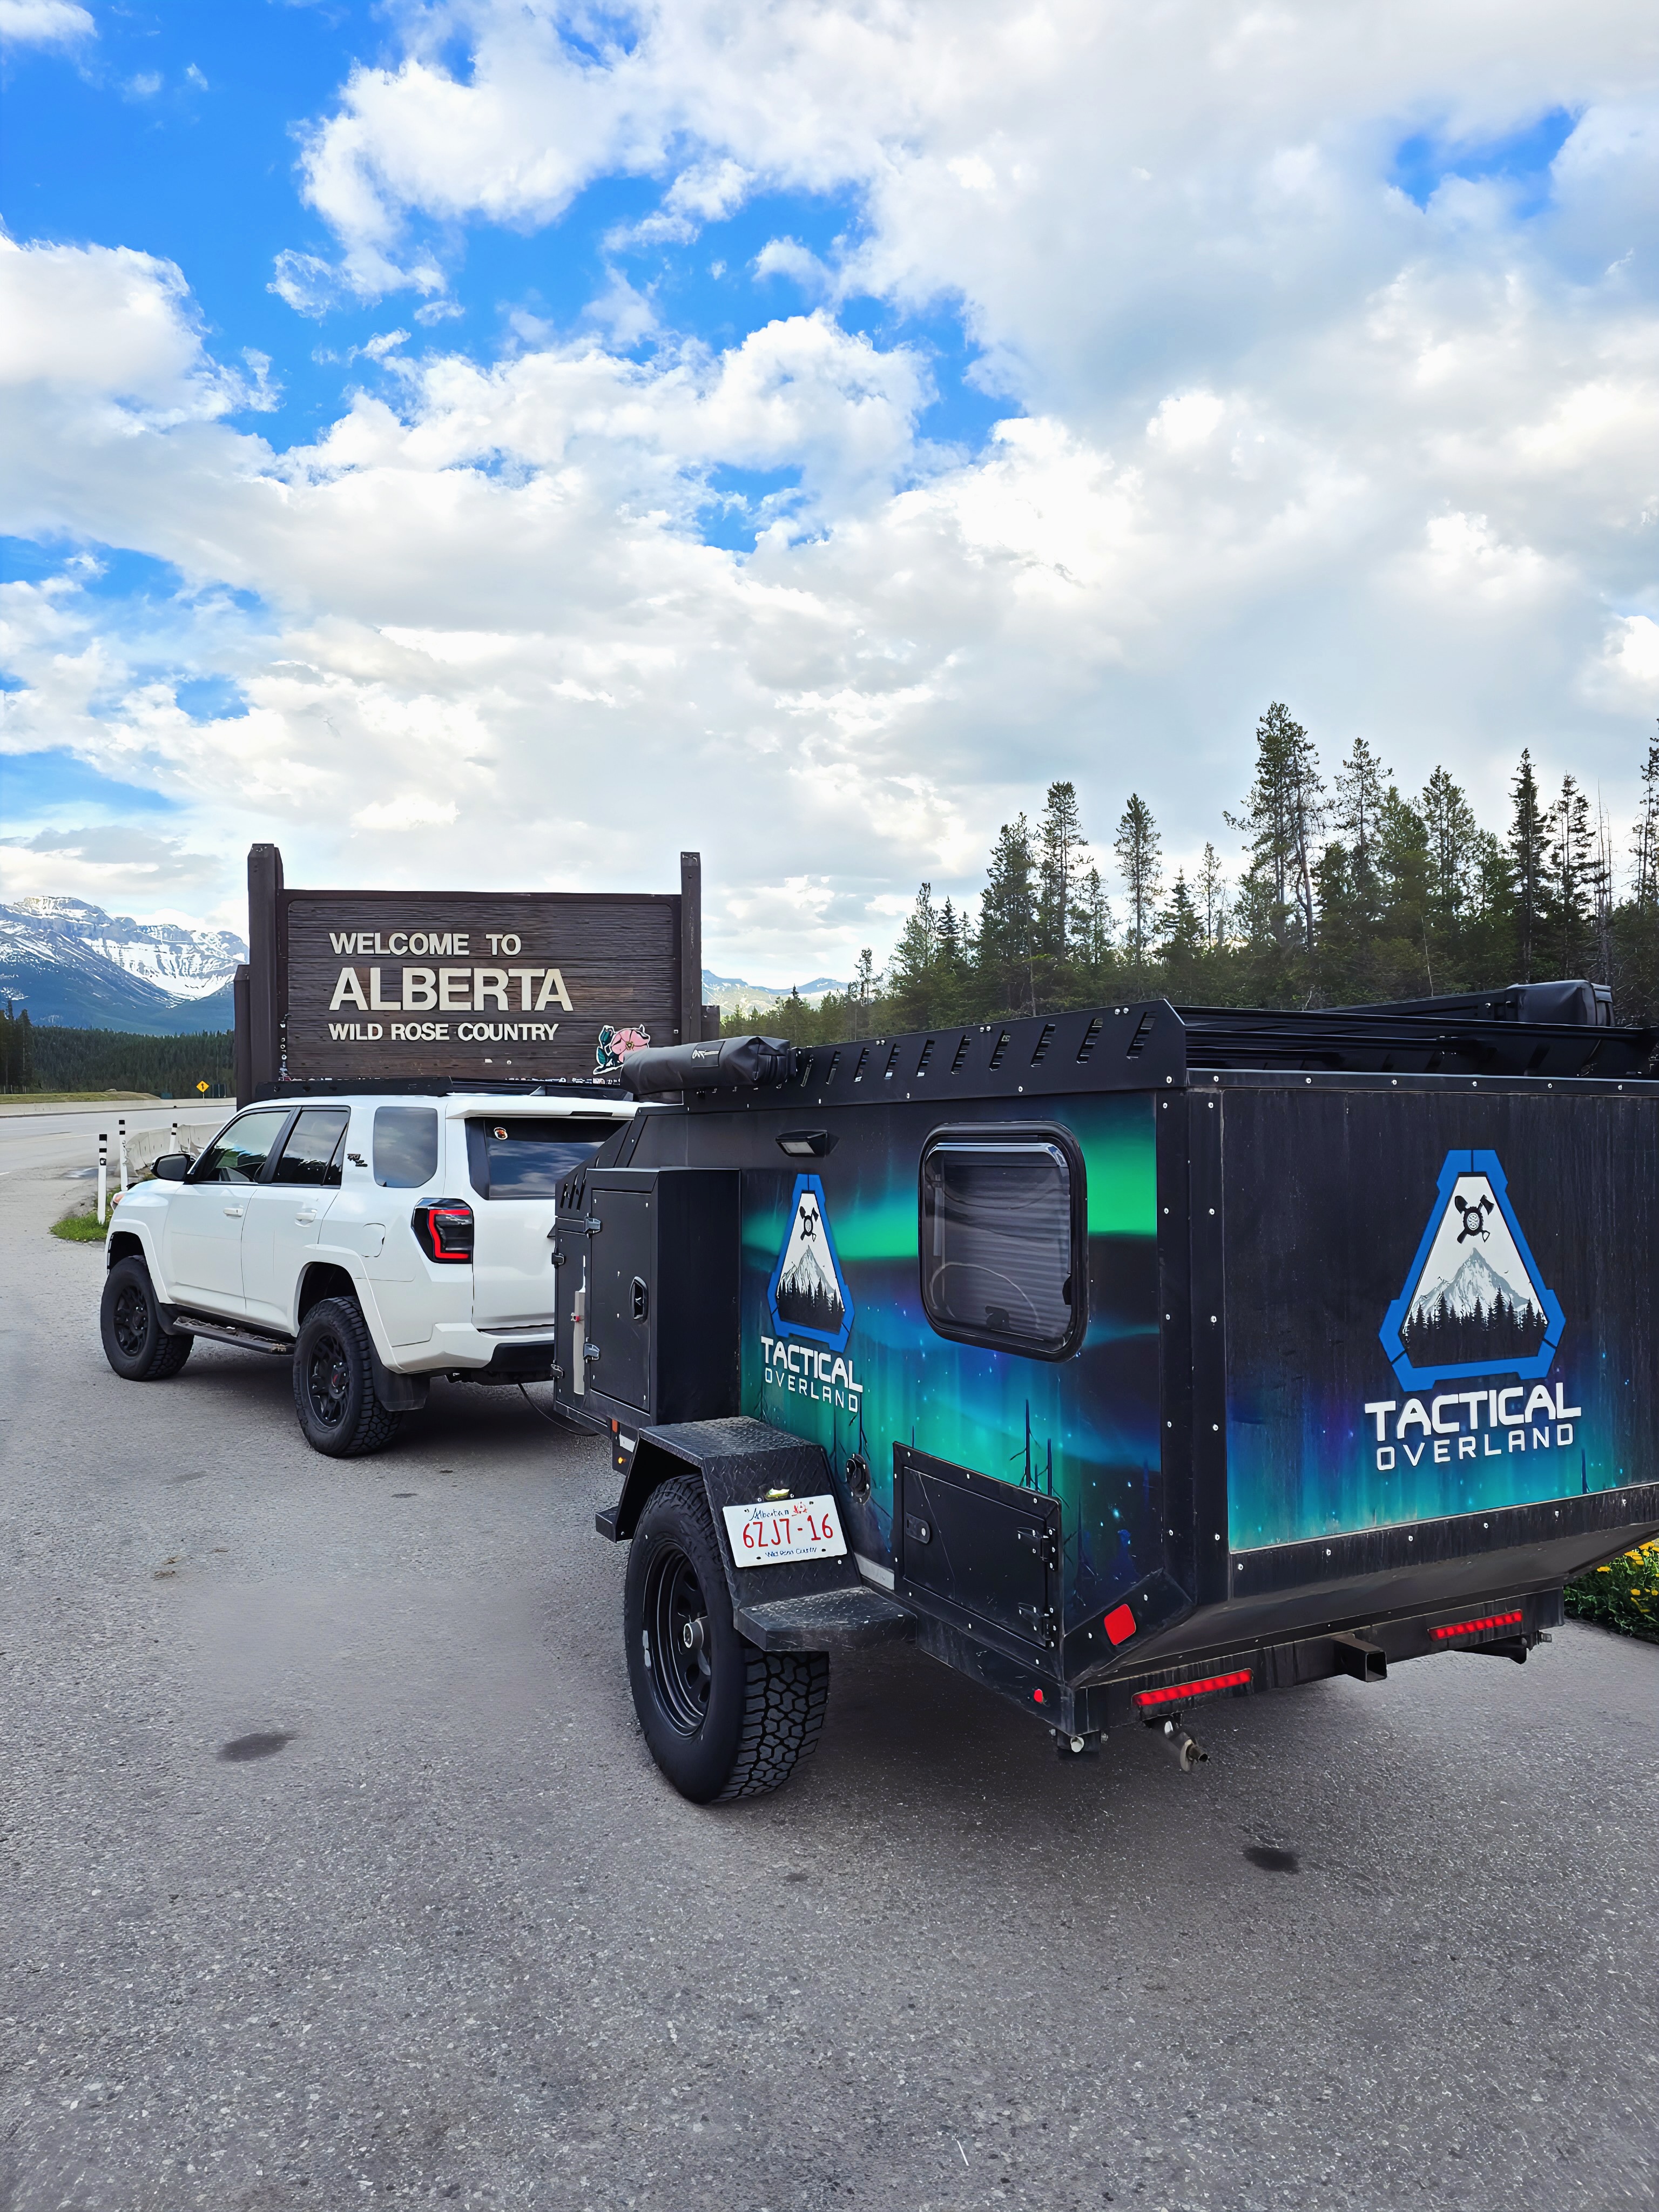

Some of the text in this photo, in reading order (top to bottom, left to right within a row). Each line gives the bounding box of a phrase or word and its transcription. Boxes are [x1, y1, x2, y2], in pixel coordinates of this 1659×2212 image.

[329, 933, 522, 955] WELCOME TO
[329, 967, 574, 1011] ALBERTA
[328, 1023, 559, 1041] WILD ROSE COUNTRY
[760, 1336, 864, 1393] TACTICAL
[765, 1367, 858, 1413] OVERLAND
[1365, 1382, 1582, 1441] TACTICAL
[1377, 1423, 1574, 1471] OVERLAND
[743, 1513, 833, 1548] 6ZJ7-16
